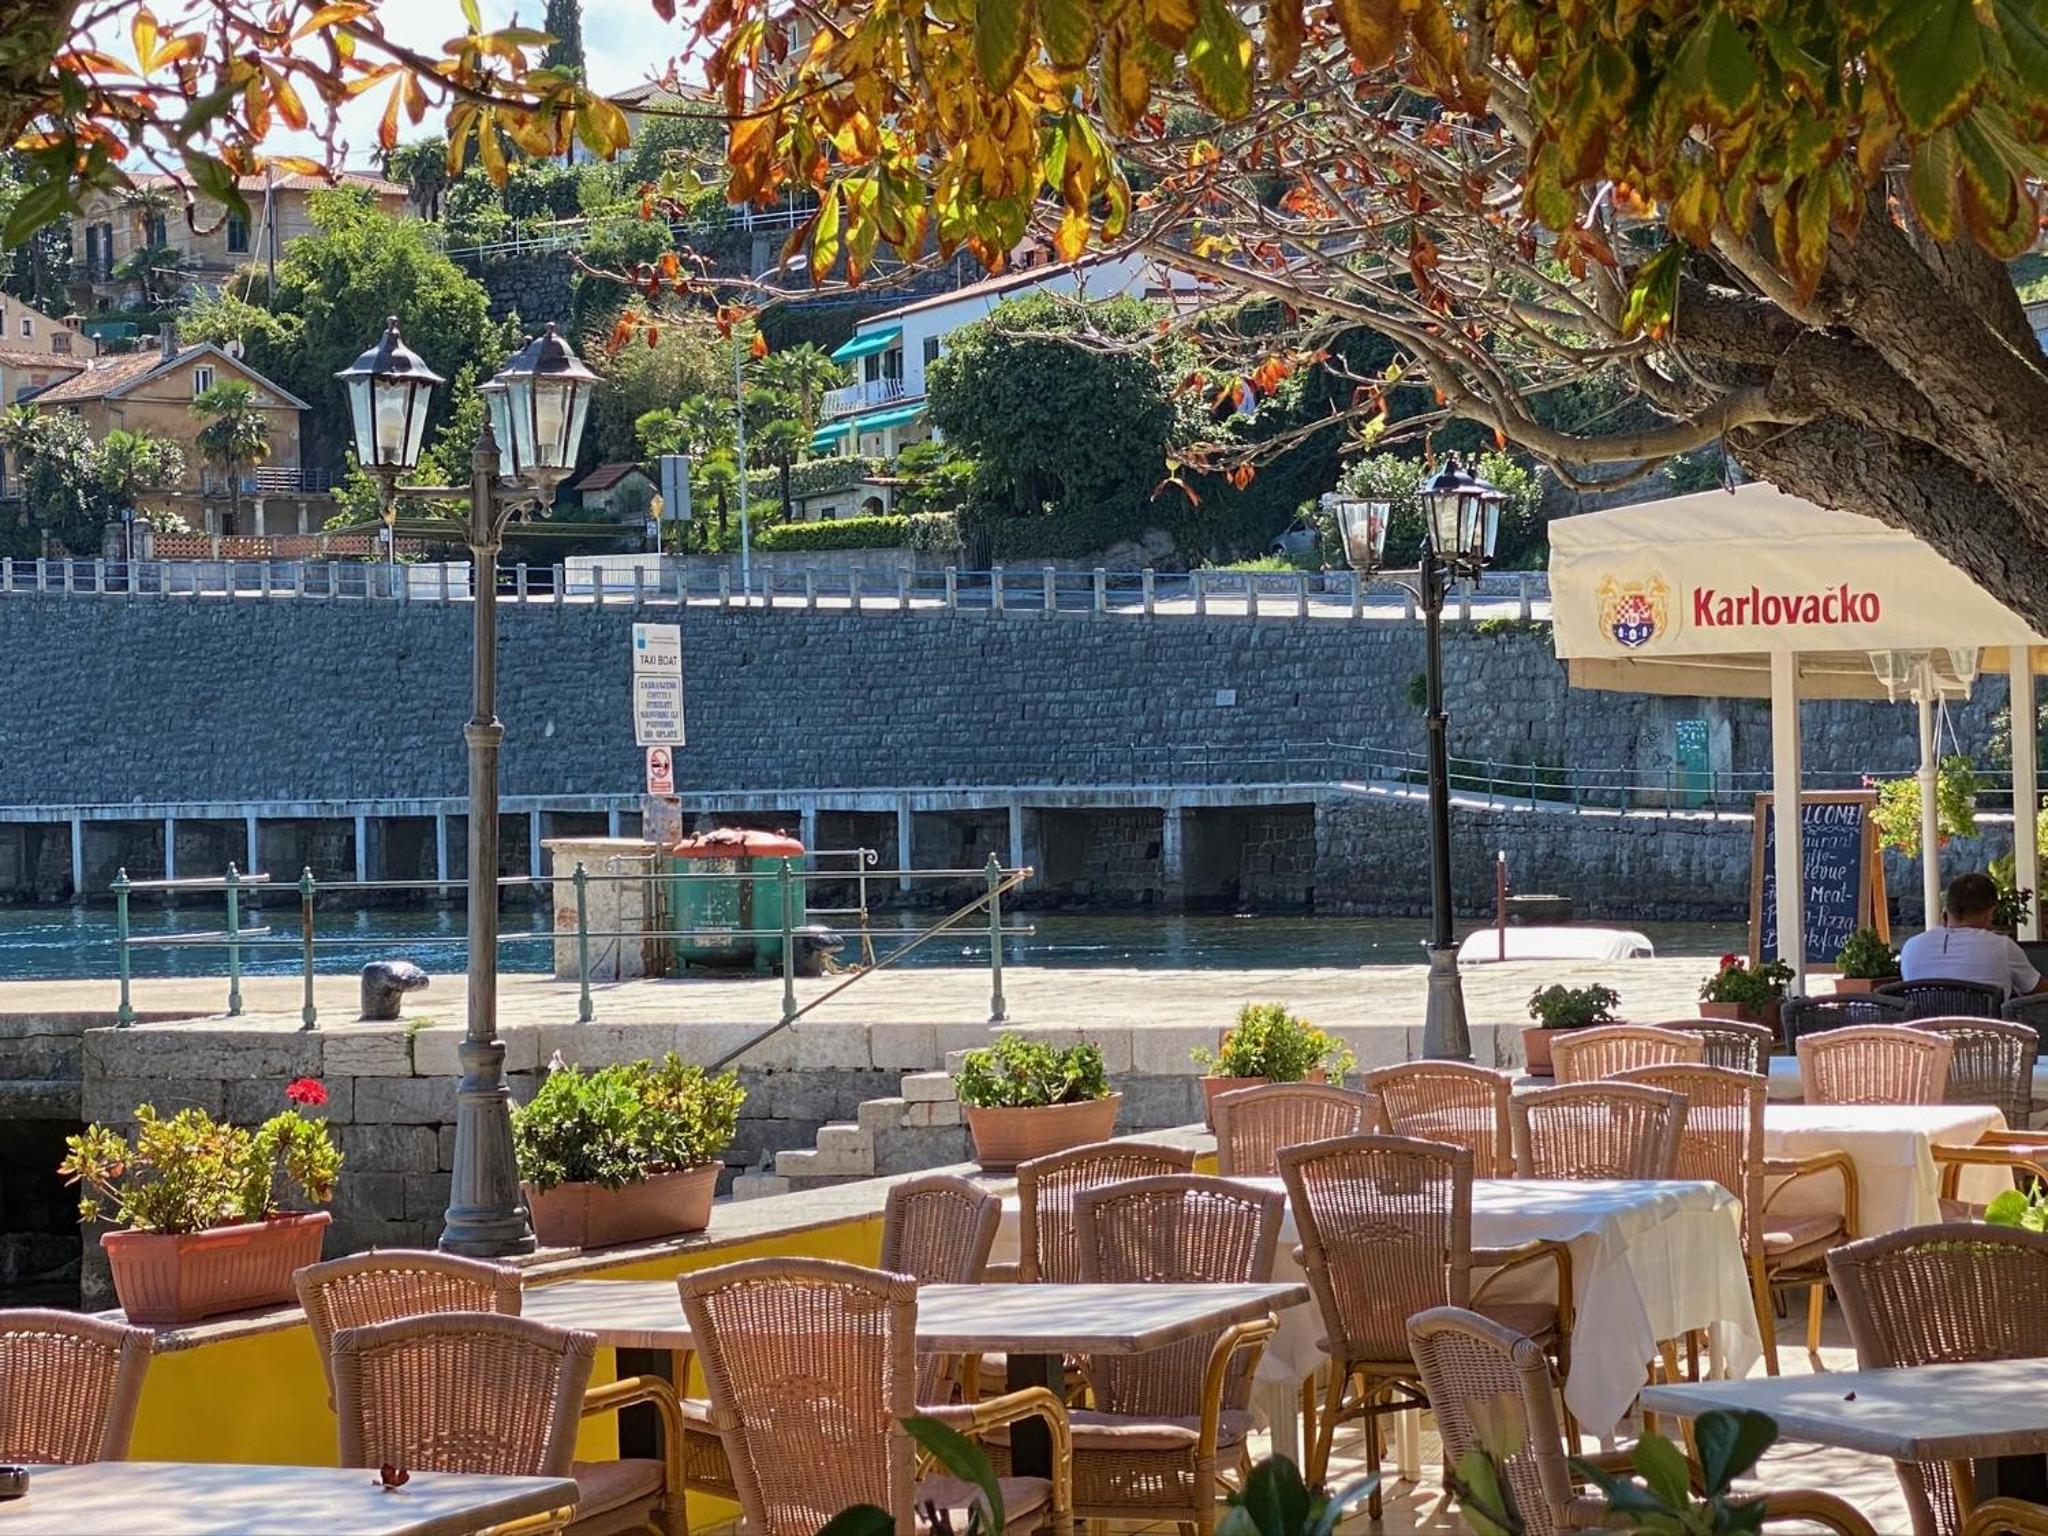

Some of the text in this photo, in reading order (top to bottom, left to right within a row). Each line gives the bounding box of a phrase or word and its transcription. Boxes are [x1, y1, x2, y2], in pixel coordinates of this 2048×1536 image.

[1693, 583, 1881, 627] Karlovačko
[640, 654, 677, 666] TAXI BOAT
